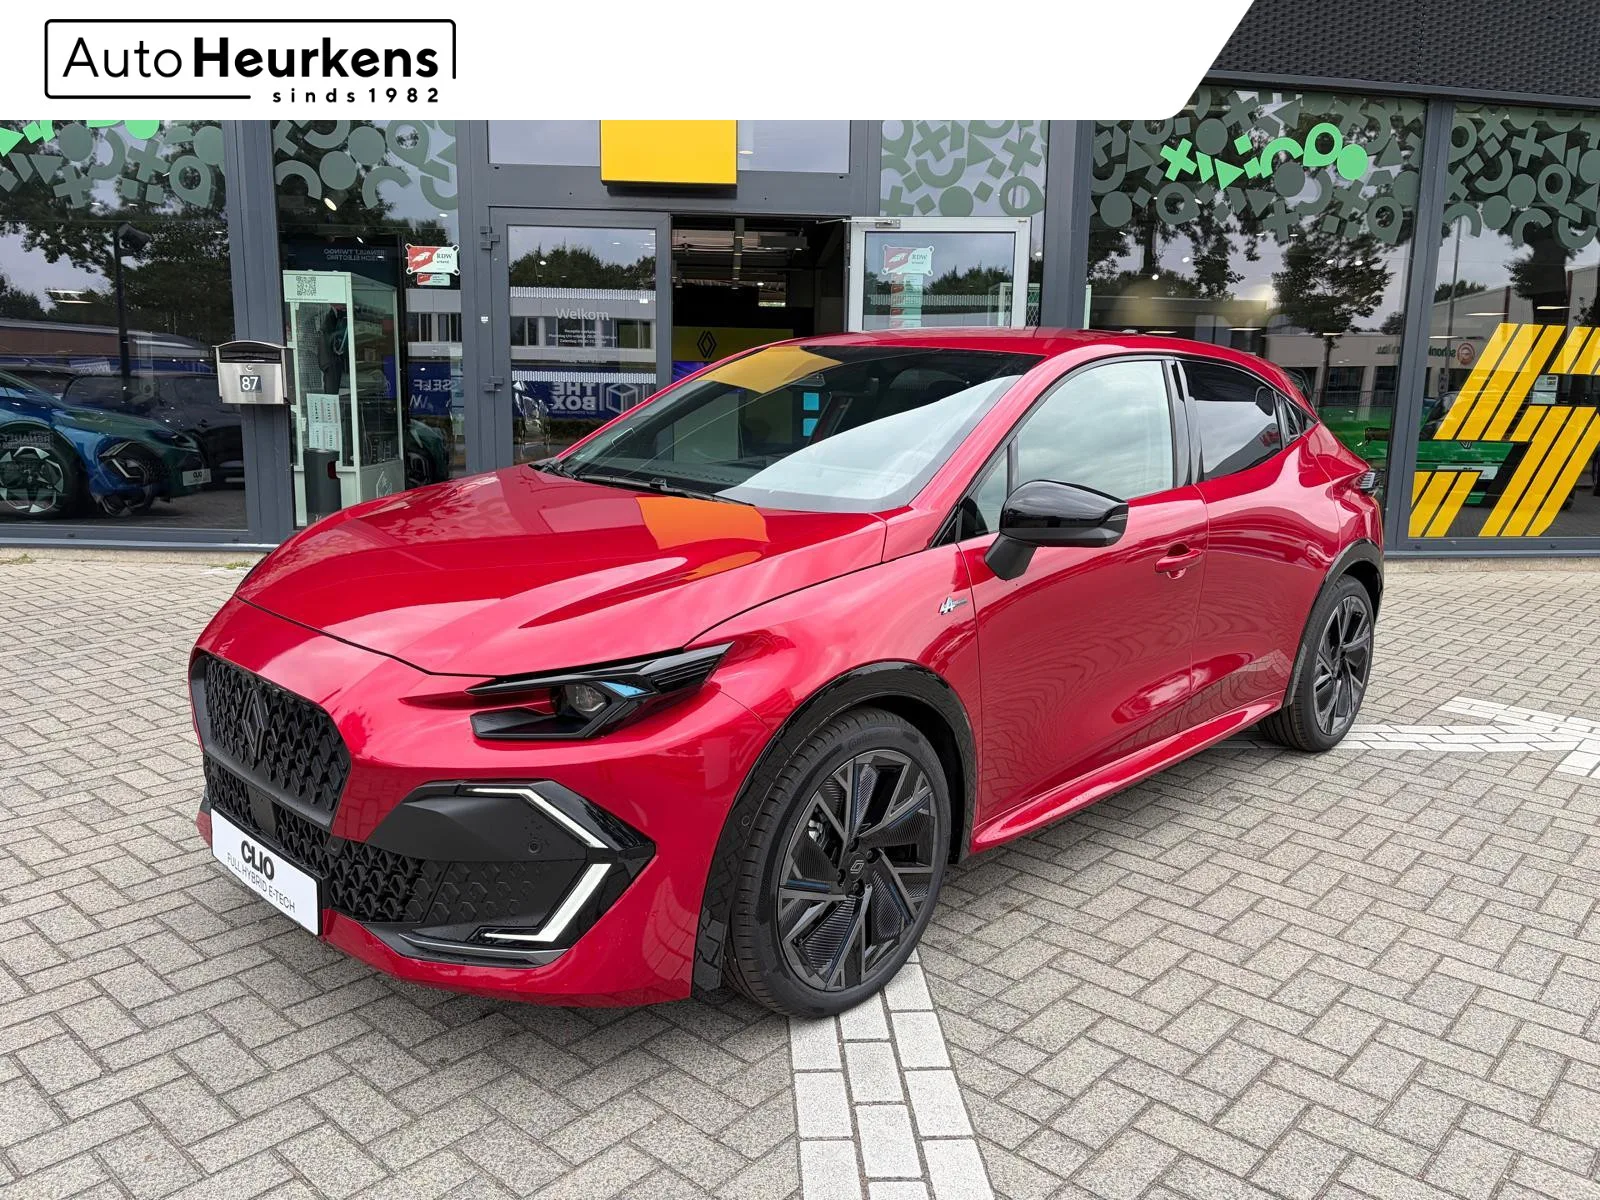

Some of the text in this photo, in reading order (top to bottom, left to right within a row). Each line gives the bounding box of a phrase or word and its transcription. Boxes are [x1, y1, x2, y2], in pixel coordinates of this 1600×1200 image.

[555, 308, 610, 321] Welkom
[241, 376, 259, 391] 87
[241, 840, 275, 880] CLIO
[227, 852, 296, 913] FULL HYBRID E-TECH
